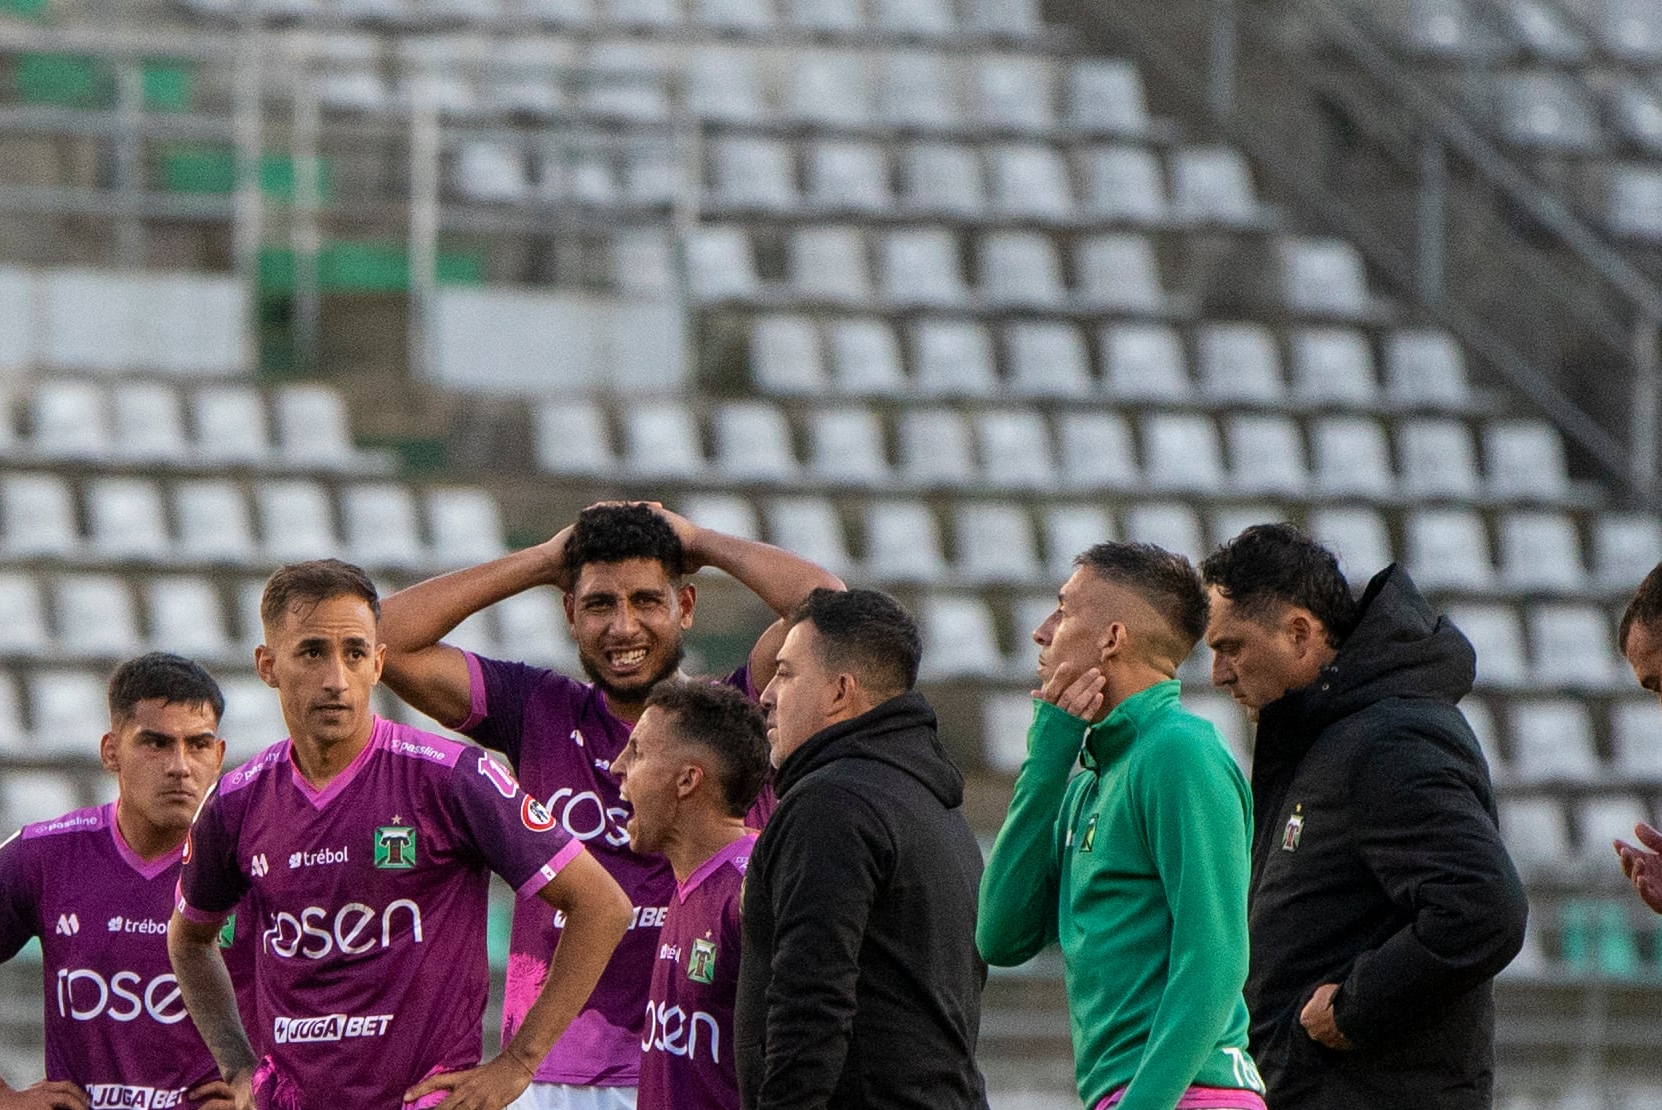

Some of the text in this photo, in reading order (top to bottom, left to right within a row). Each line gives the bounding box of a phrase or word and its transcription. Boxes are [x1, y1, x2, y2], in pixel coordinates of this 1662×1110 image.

[400, 741, 445, 761] passline
[48, 814, 98, 832] passline
[547, 787, 631, 847] ros
[303, 845, 350, 868] trébol
[57, 968, 189, 1025] rose
